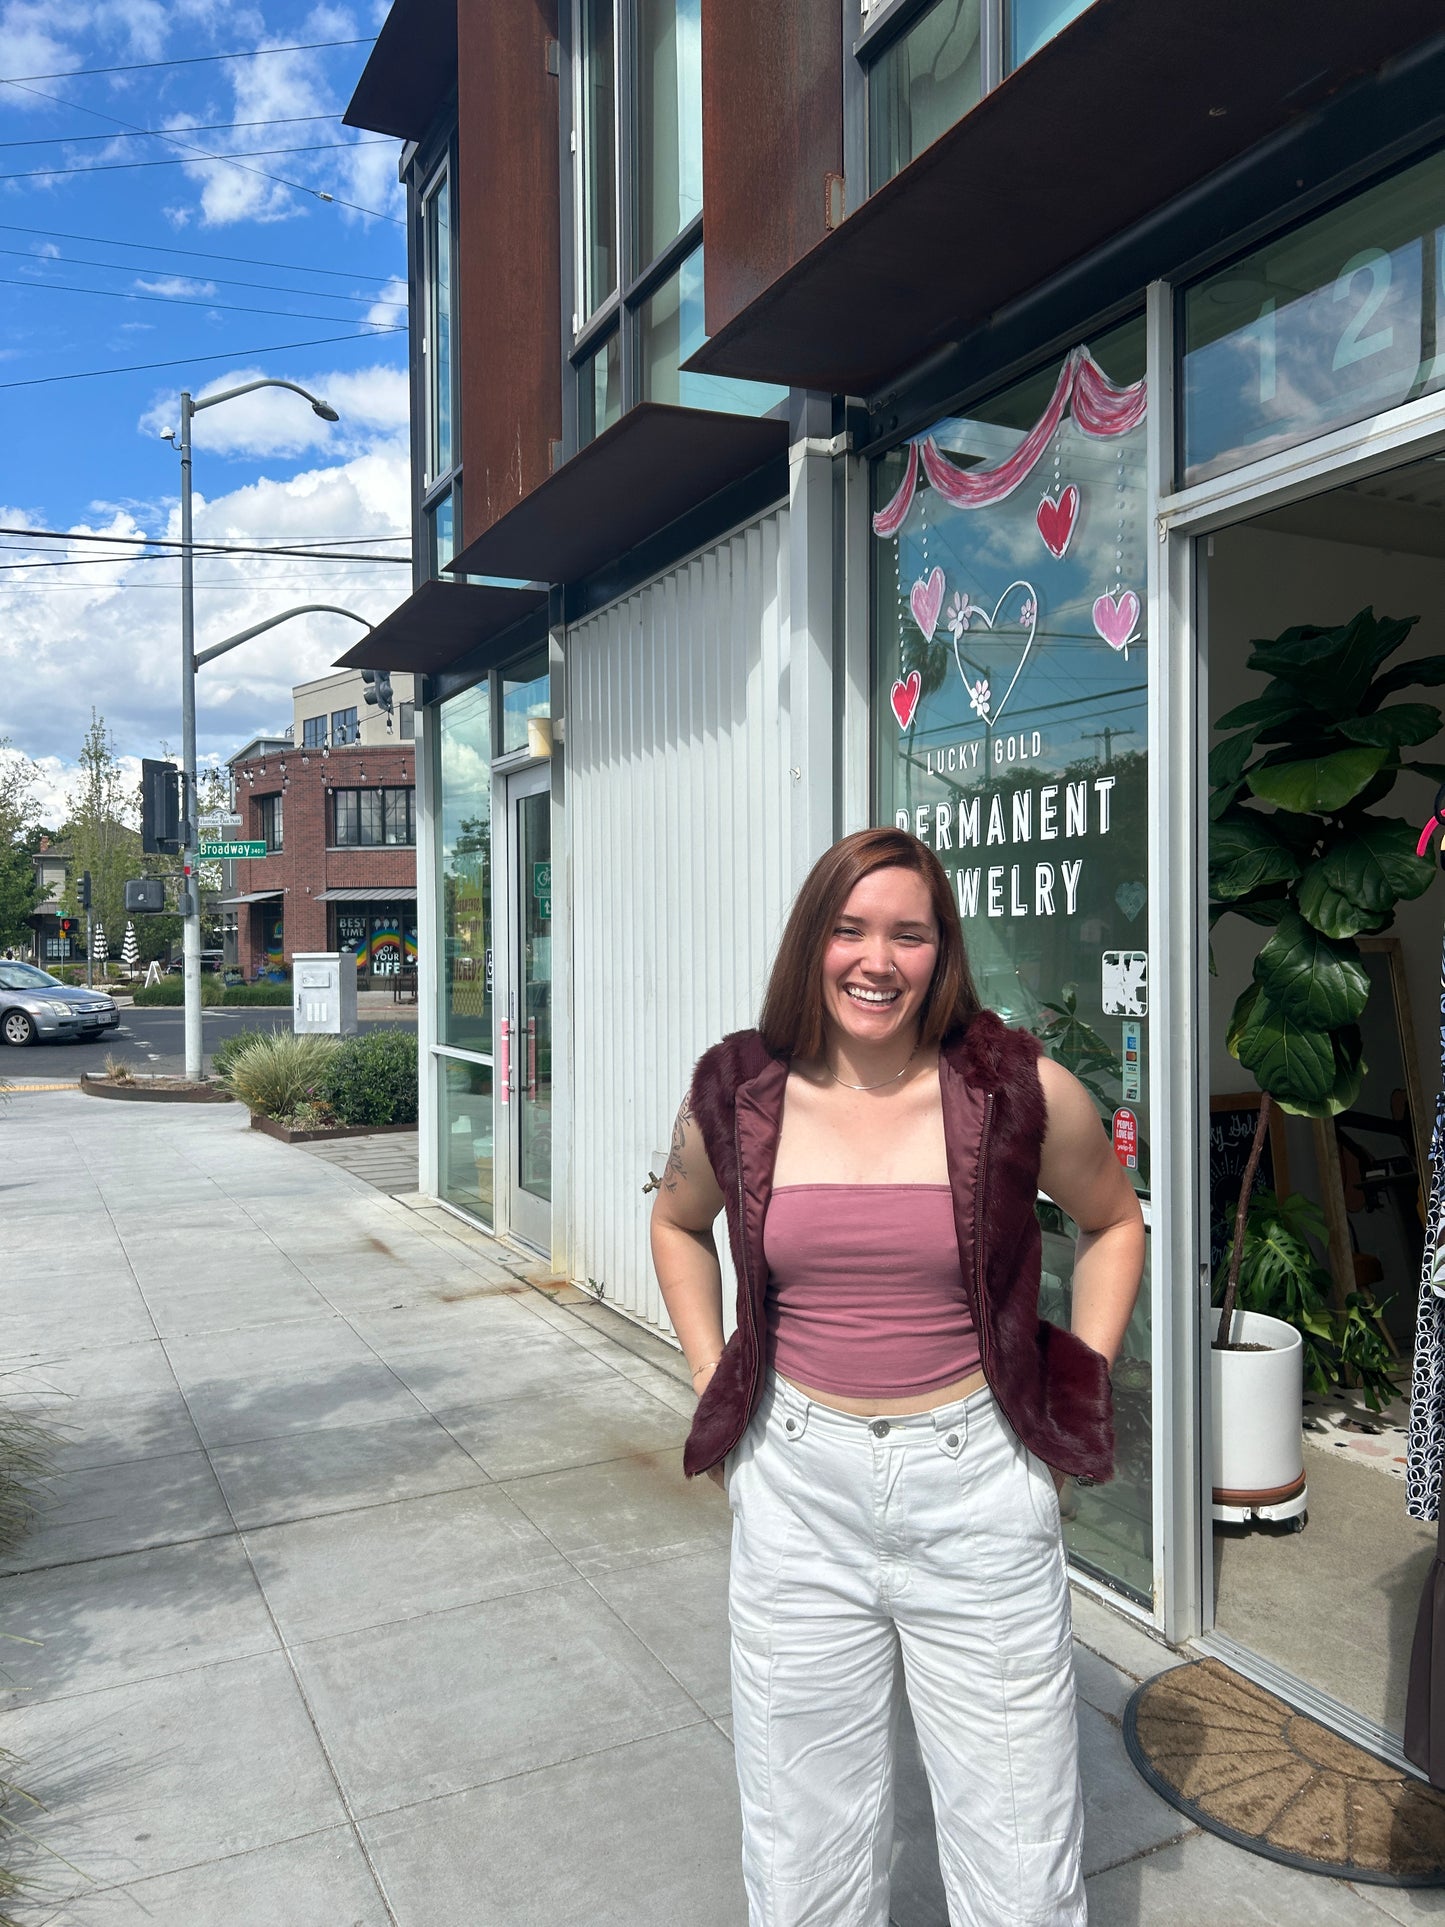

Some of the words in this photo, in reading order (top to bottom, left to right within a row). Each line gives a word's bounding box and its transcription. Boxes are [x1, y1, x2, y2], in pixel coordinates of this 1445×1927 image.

[927, 742, 979, 775] LUCKY
[994, 731, 1041, 763] GOLD
[200, 843, 250, 856] Broadway
[945, 860, 1083, 918] WELRY
[340, 918, 367, 928] BEST
[341, 928, 364, 937] TIME
[374, 953, 399, 961] YOUR
[373, 962, 400, 975] LIFE
[1116, 1119, 1134, 1131] PEOPLE
[1116, 1129, 1127, 1139] LOVE
